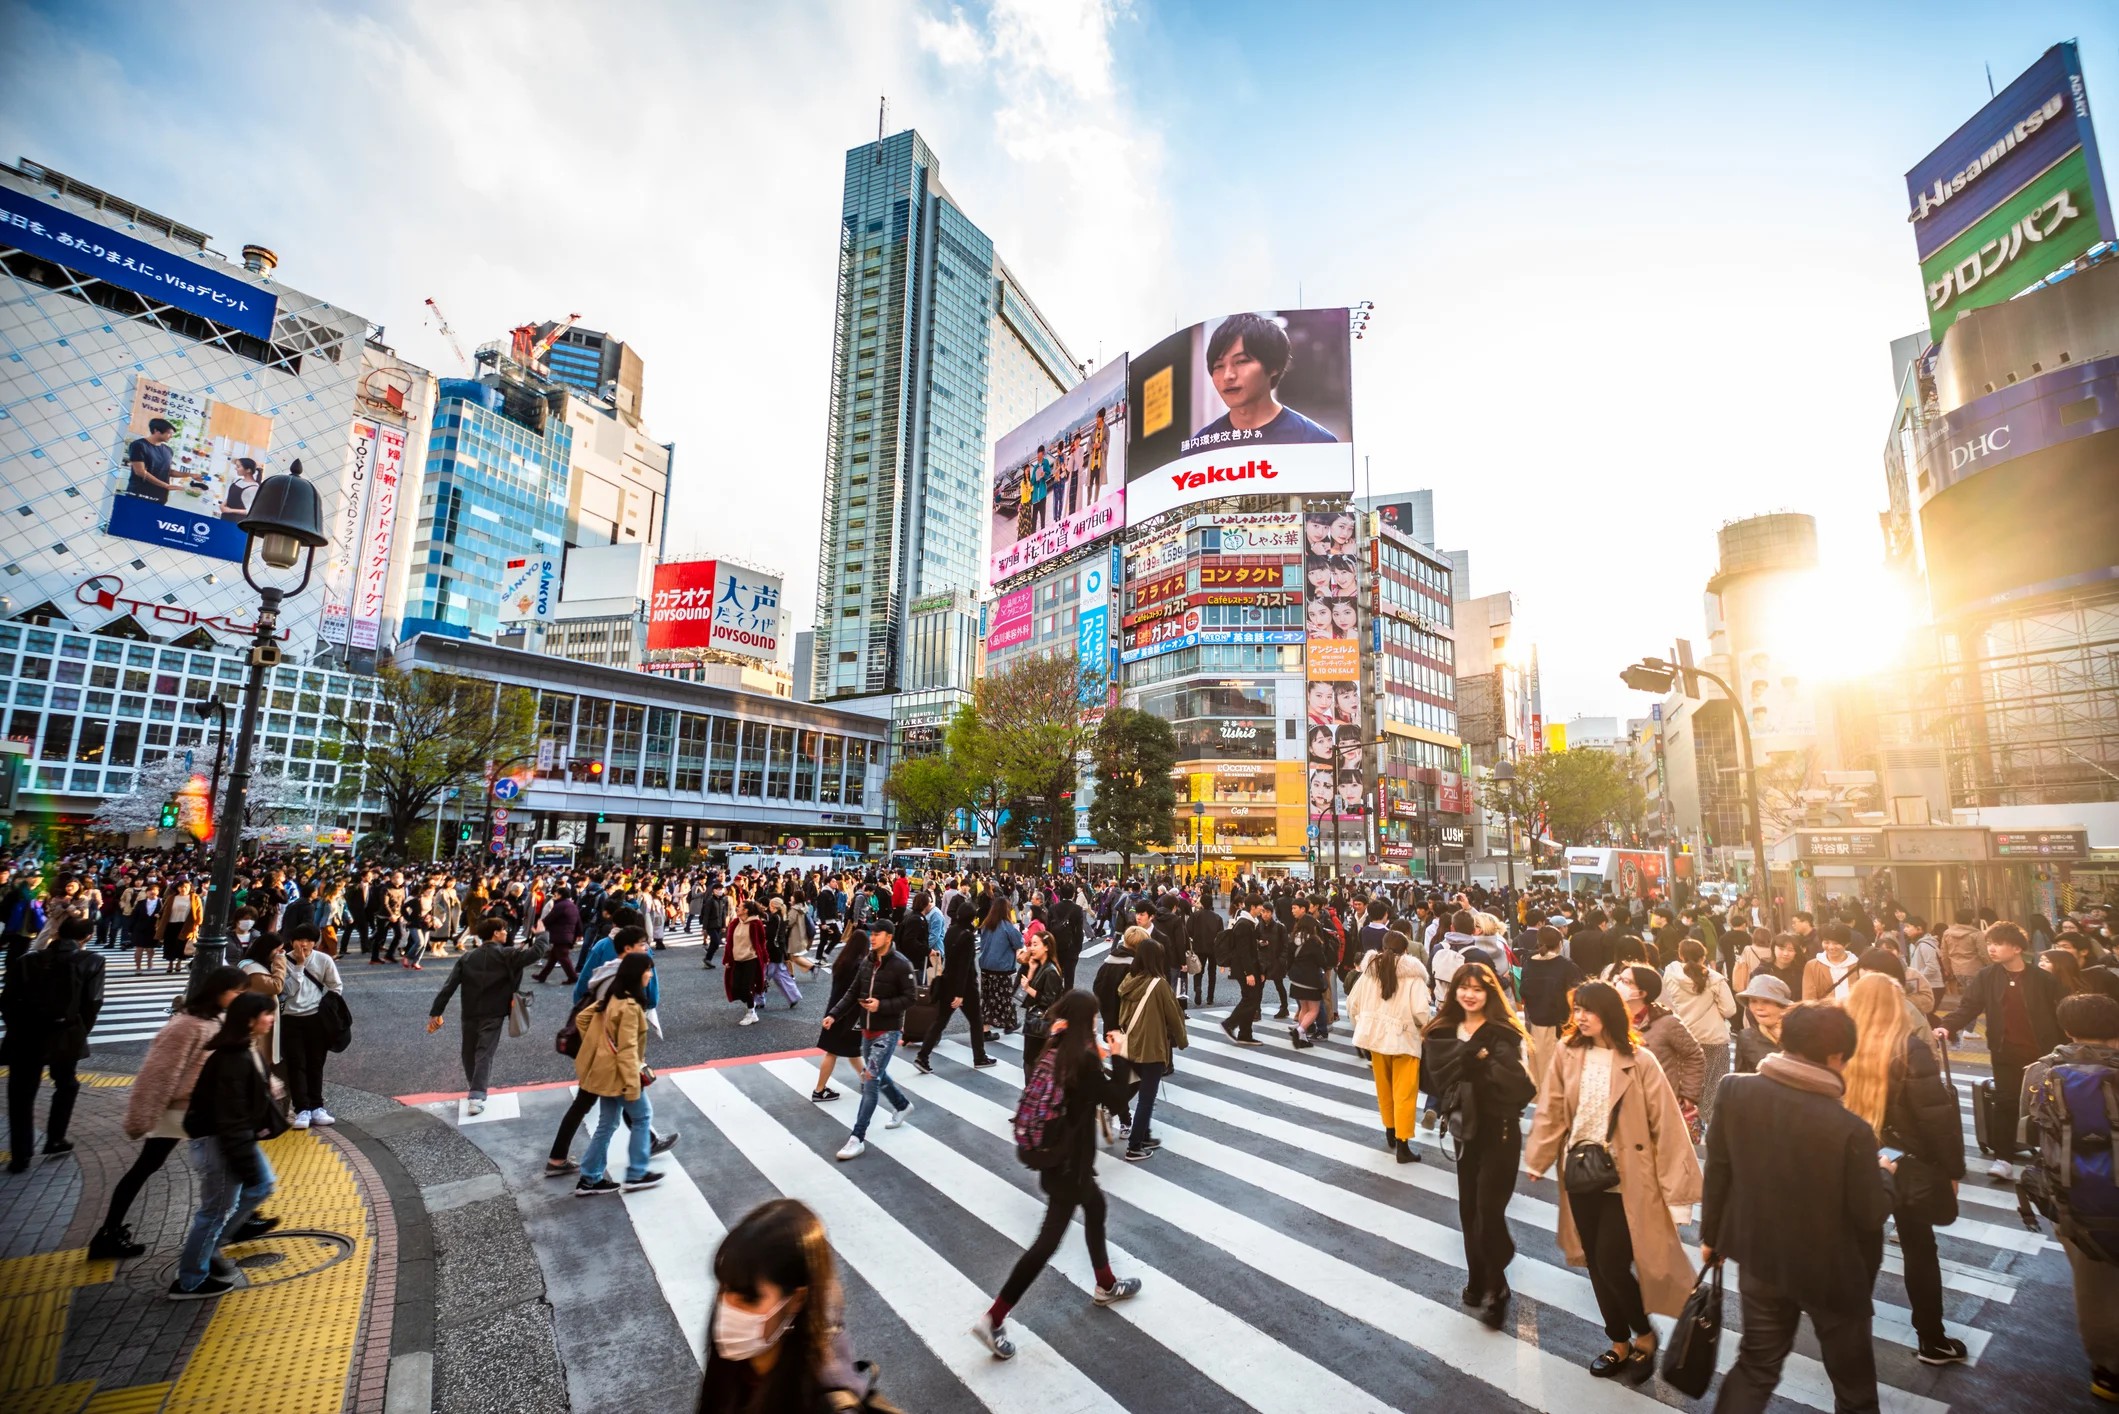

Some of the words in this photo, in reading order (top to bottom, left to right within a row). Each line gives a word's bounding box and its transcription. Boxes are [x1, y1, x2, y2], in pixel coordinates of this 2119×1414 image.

[1908, 92, 2063, 224] Hisamitsu
[1926, 187, 2079, 312] サロンパス
[1950, 425, 2012, 471] DHC
[1171, 460, 1278, 491] Yakult
[157, 520, 186, 534] VISA
[1248, 530, 1299, 546] しゃぶ葉
[1126, 562, 1136, 574] 9F
[1201, 567, 1280, 583] コンタクト
[502, 562, 539, 602] SANKYO
[537, 561, 554, 615] SANKYO
[654, 588, 712, 608] カラオケ
[717, 575, 780, 612] 大声
[1256, 592, 1294, 606] ガスト
[652, 606, 711, 622] JOYSOUND
[1164, 599, 1188, 616] ガスト
[117, 597, 290, 641] TOKYU
[712, 624, 776, 650] JOYSOUND
[1125, 634, 1136, 646] 7F
[1151, 621, 1182, 643] ガスト
[1233, 632, 1304, 643] 英会話イーオン
[1310, 645, 1356, 654] アンジュルム
[896, 718, 923, 727] MARK
[1220, 727, 1257, 738] Ushi8
[1217, 764, 1262, 772] L'OCCITANE
[1443, 787, 1459, 800] アコム
[1230, 806, 1249, 816] Café
[1441, 827, 1464, 843] LUSH
[1810, 843, 1850, 855] 渋谷駅
